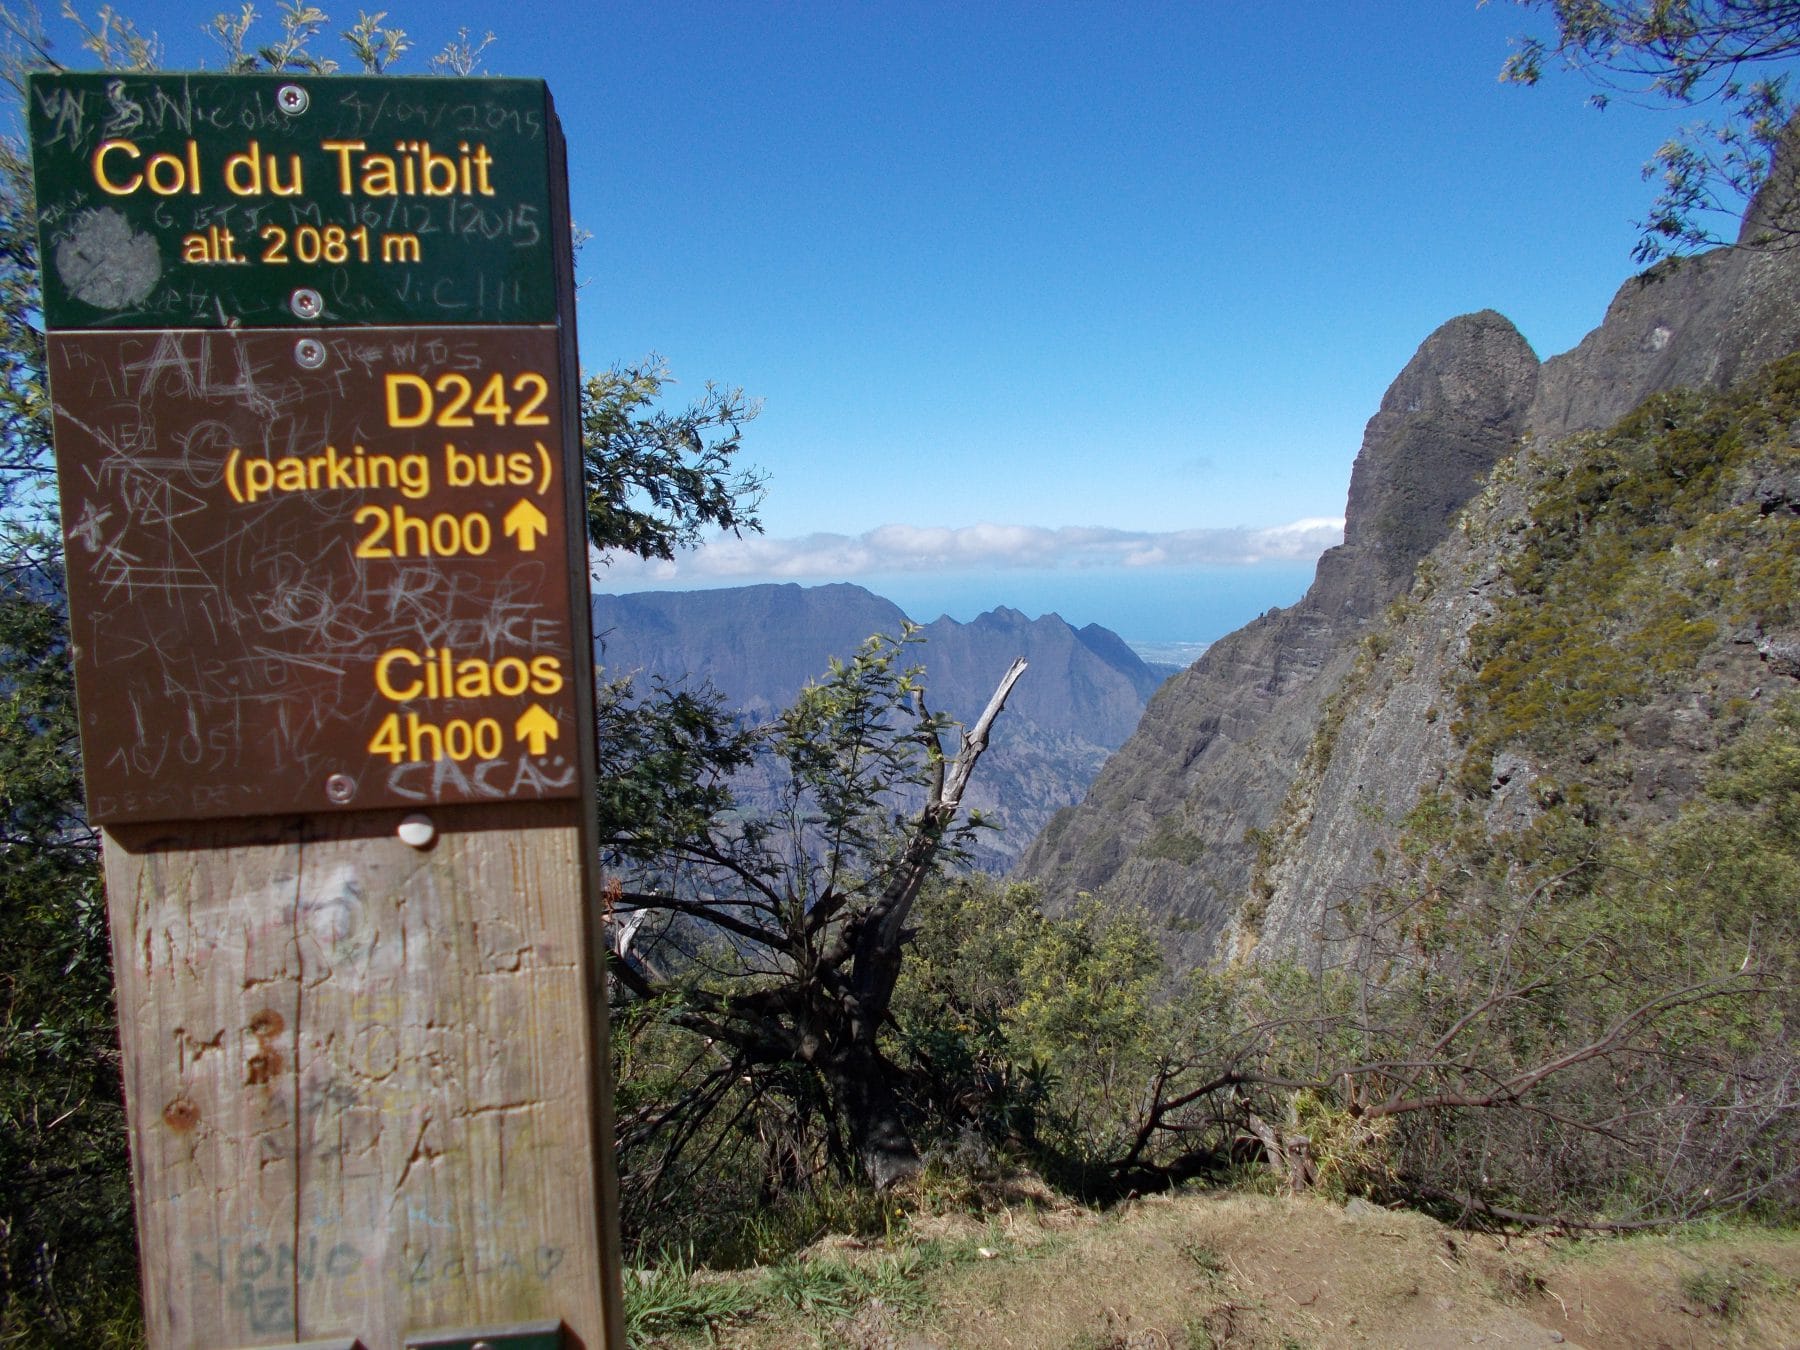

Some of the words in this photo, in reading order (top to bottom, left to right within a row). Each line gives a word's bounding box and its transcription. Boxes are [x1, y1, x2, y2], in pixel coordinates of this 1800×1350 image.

[93, 139, 201, 195] Col
[224, 141, 302, 196] du
[322, 141, 494, 196] Taïbit
[184, 226, 247, 263] alt.
[382, 234, 421, 263] m
[385, 372, 550, 428] D242
[224, 445, 431, 503] (parking
[445, 441, 553, 495] bus)
[353, 504, 492, 559] 2h00
[374, 646, 564, 702] Cilaos
[366, 711, 503, 764] 4h00
[387, 753, 542, 801] CACA
